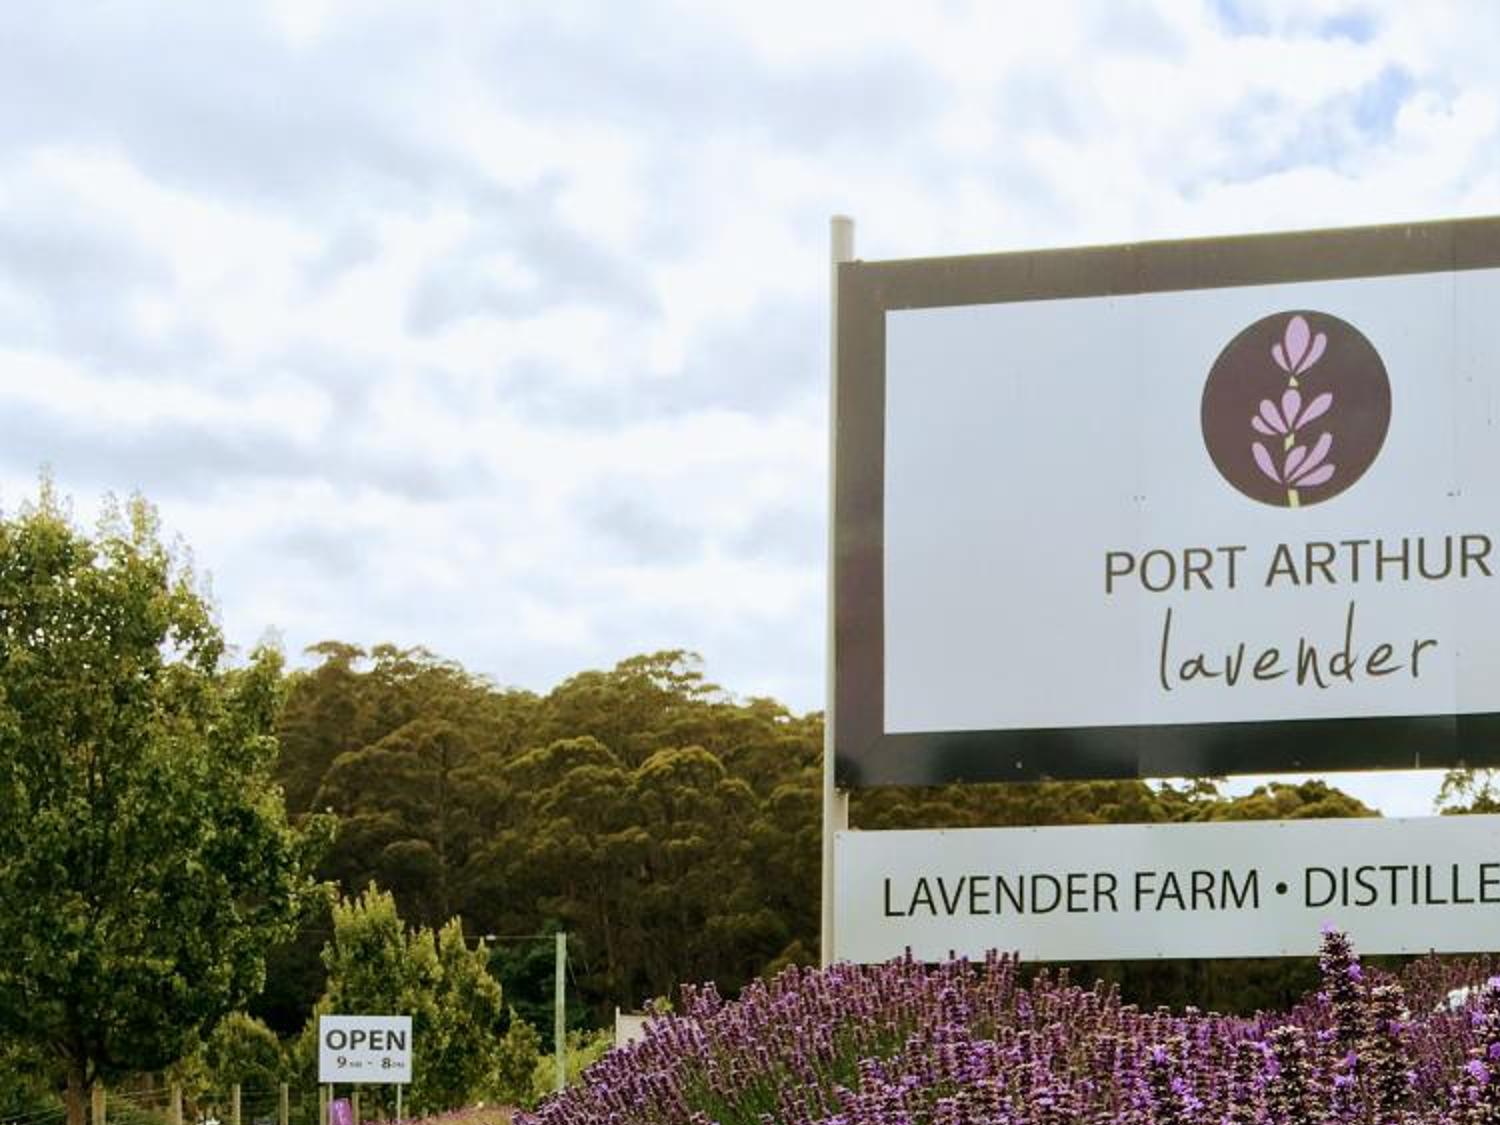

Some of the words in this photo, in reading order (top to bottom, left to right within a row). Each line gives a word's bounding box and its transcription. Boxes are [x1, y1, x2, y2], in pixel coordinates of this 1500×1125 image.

[1106, 545, 1247, 595] PORT
[1264, 534, 1493, 588] ARTHUR
[1159, 600, 1438, 692] lavender
[884, 872, 1118, 918] LAVENDER
[1134, 868, 1259, 912] FARM
[325, 1029, 406, 1051] OPEN
